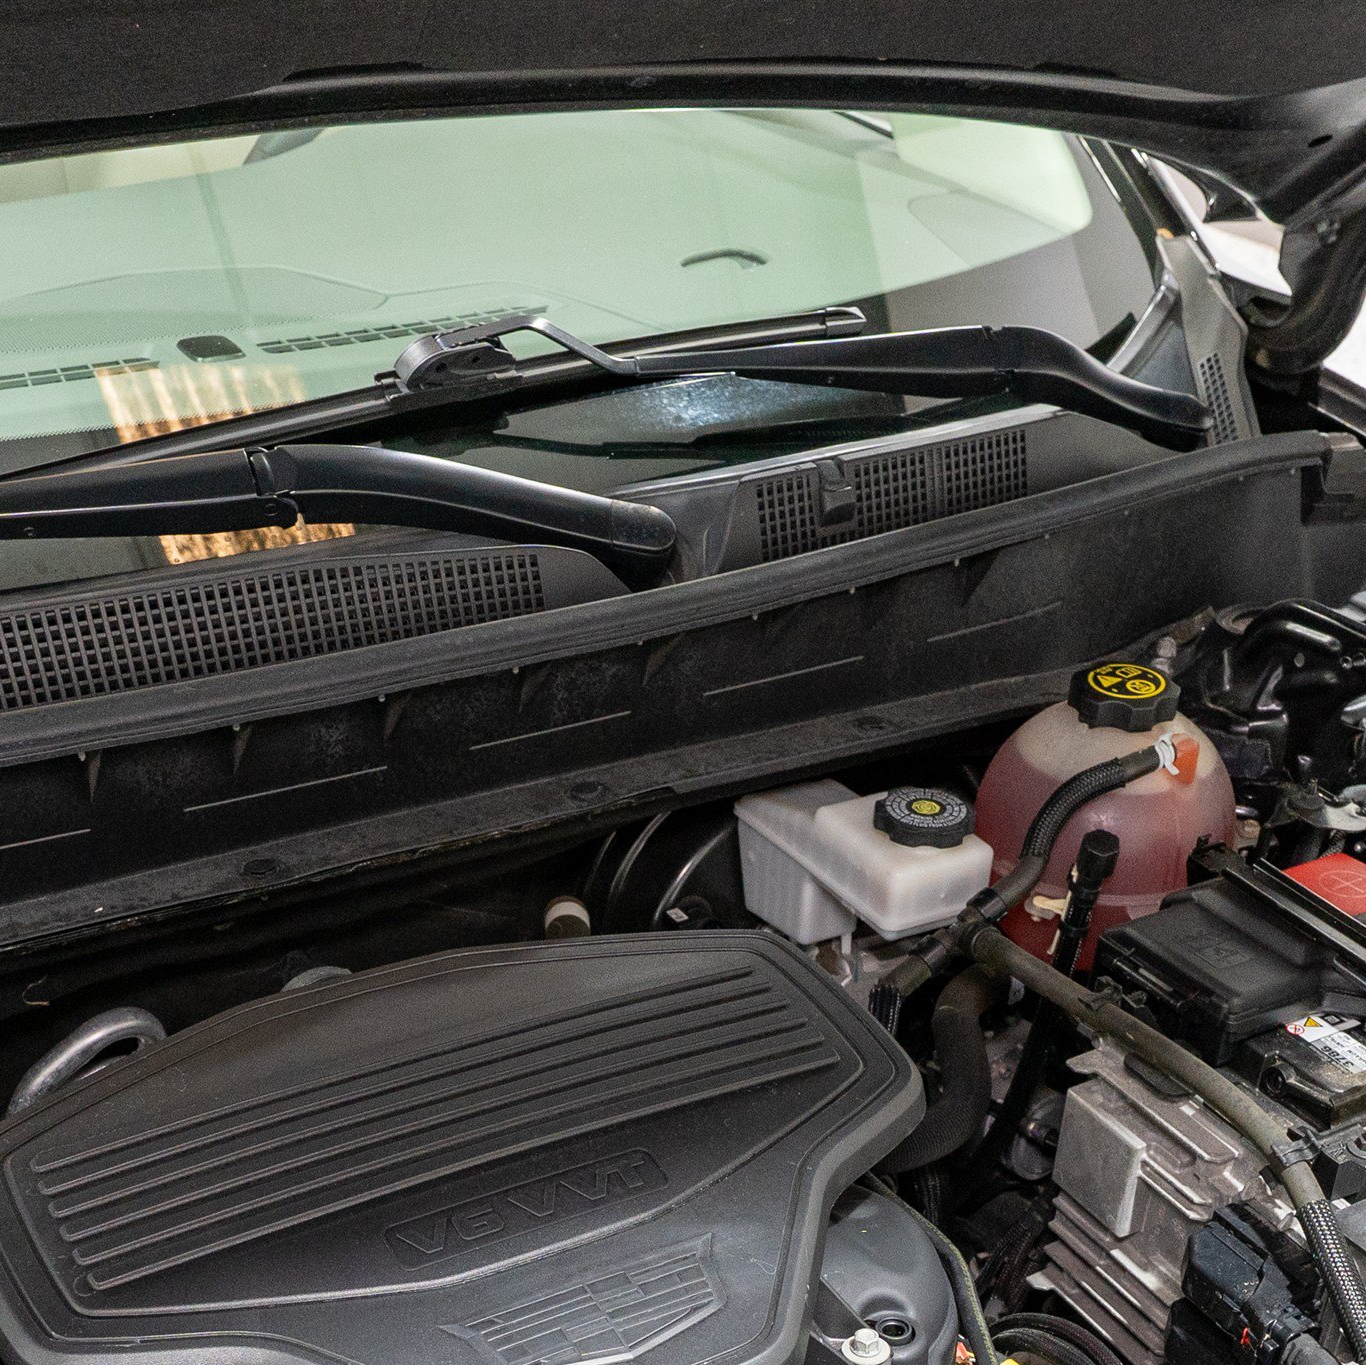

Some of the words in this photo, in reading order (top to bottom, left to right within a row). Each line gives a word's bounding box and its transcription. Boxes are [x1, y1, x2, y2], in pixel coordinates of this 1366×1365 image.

[1321, 1045, 1354, 1068] 3786
[396, 1208, 505, 1254] V6
[508, 1159, 645, 1217] VVT
